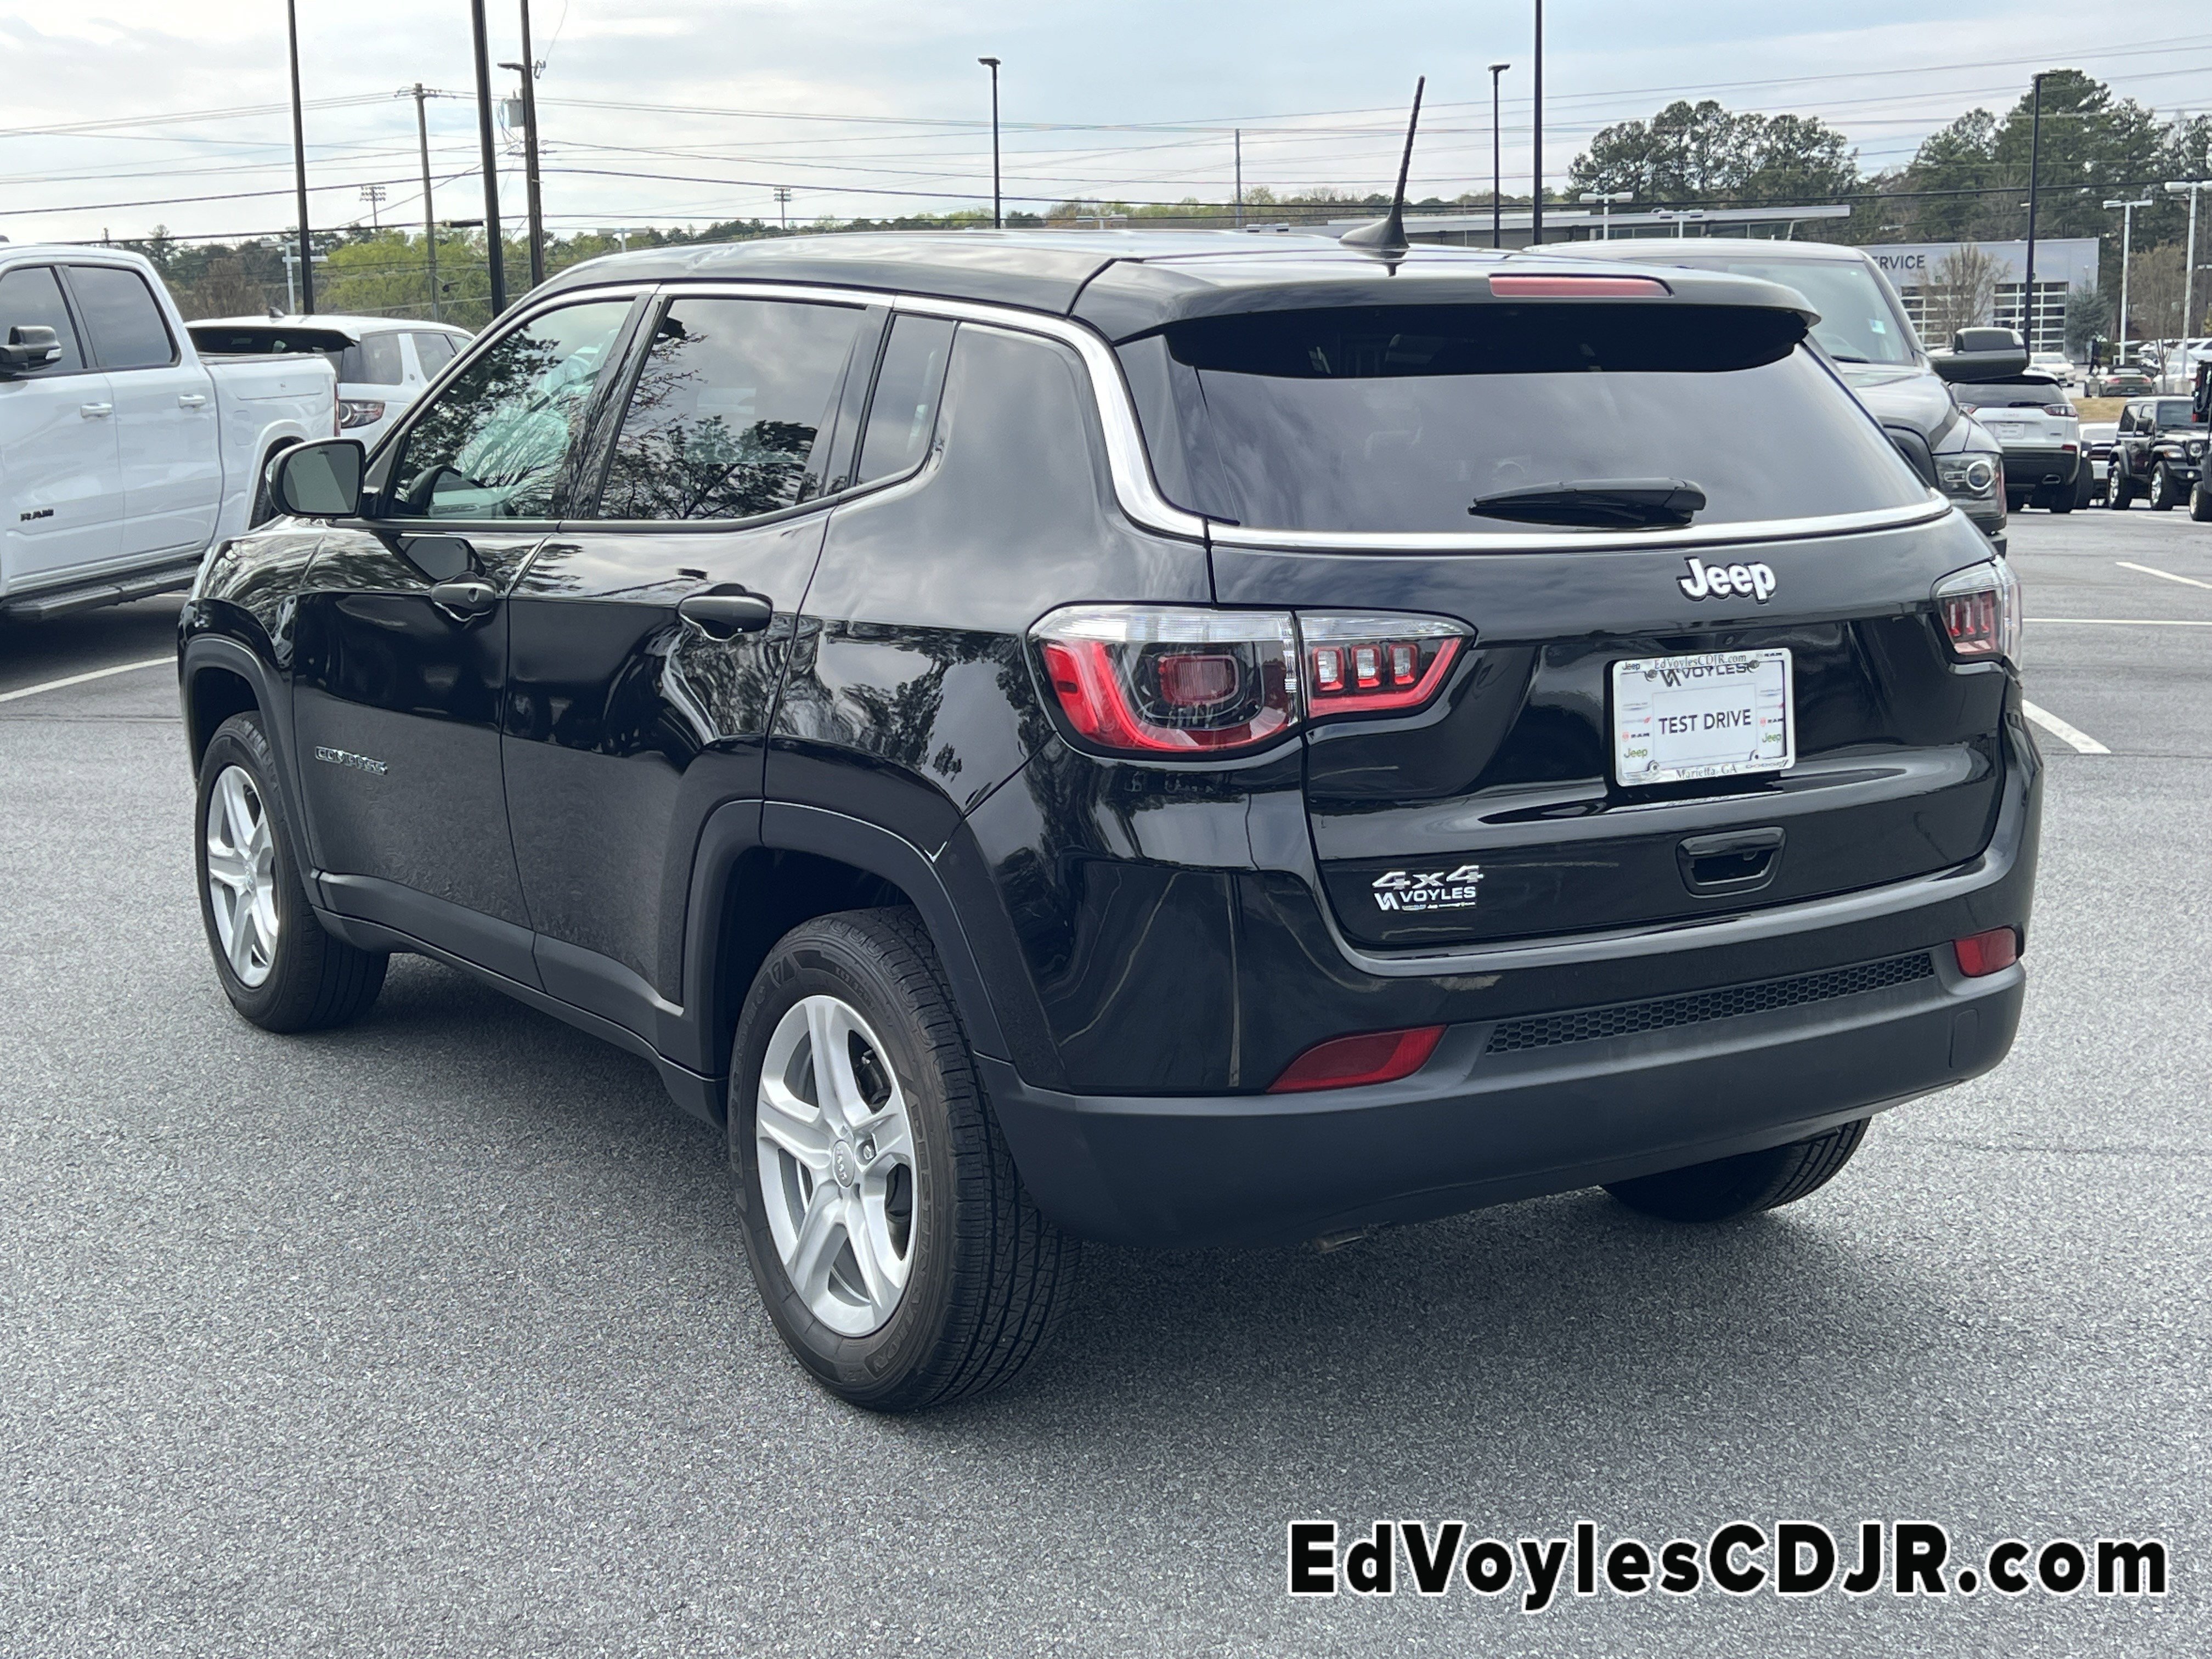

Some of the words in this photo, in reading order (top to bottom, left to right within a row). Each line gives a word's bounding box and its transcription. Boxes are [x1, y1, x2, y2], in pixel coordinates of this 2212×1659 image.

[20, 508, 54, 522] RAM
[1679, 557, 1776, 602] Jeep
[1654, 653, 1746, 669] EdVoylesCDJR.com
[1658, 714, 1698, 735] TEST
[1703, 709, 1751, 730] DRIVE
[1762, 732, 1782, 743] Jeep
[1623, 747, 1648, 759] Jeep
[1400, 886, 1476, 902] VOYLES
